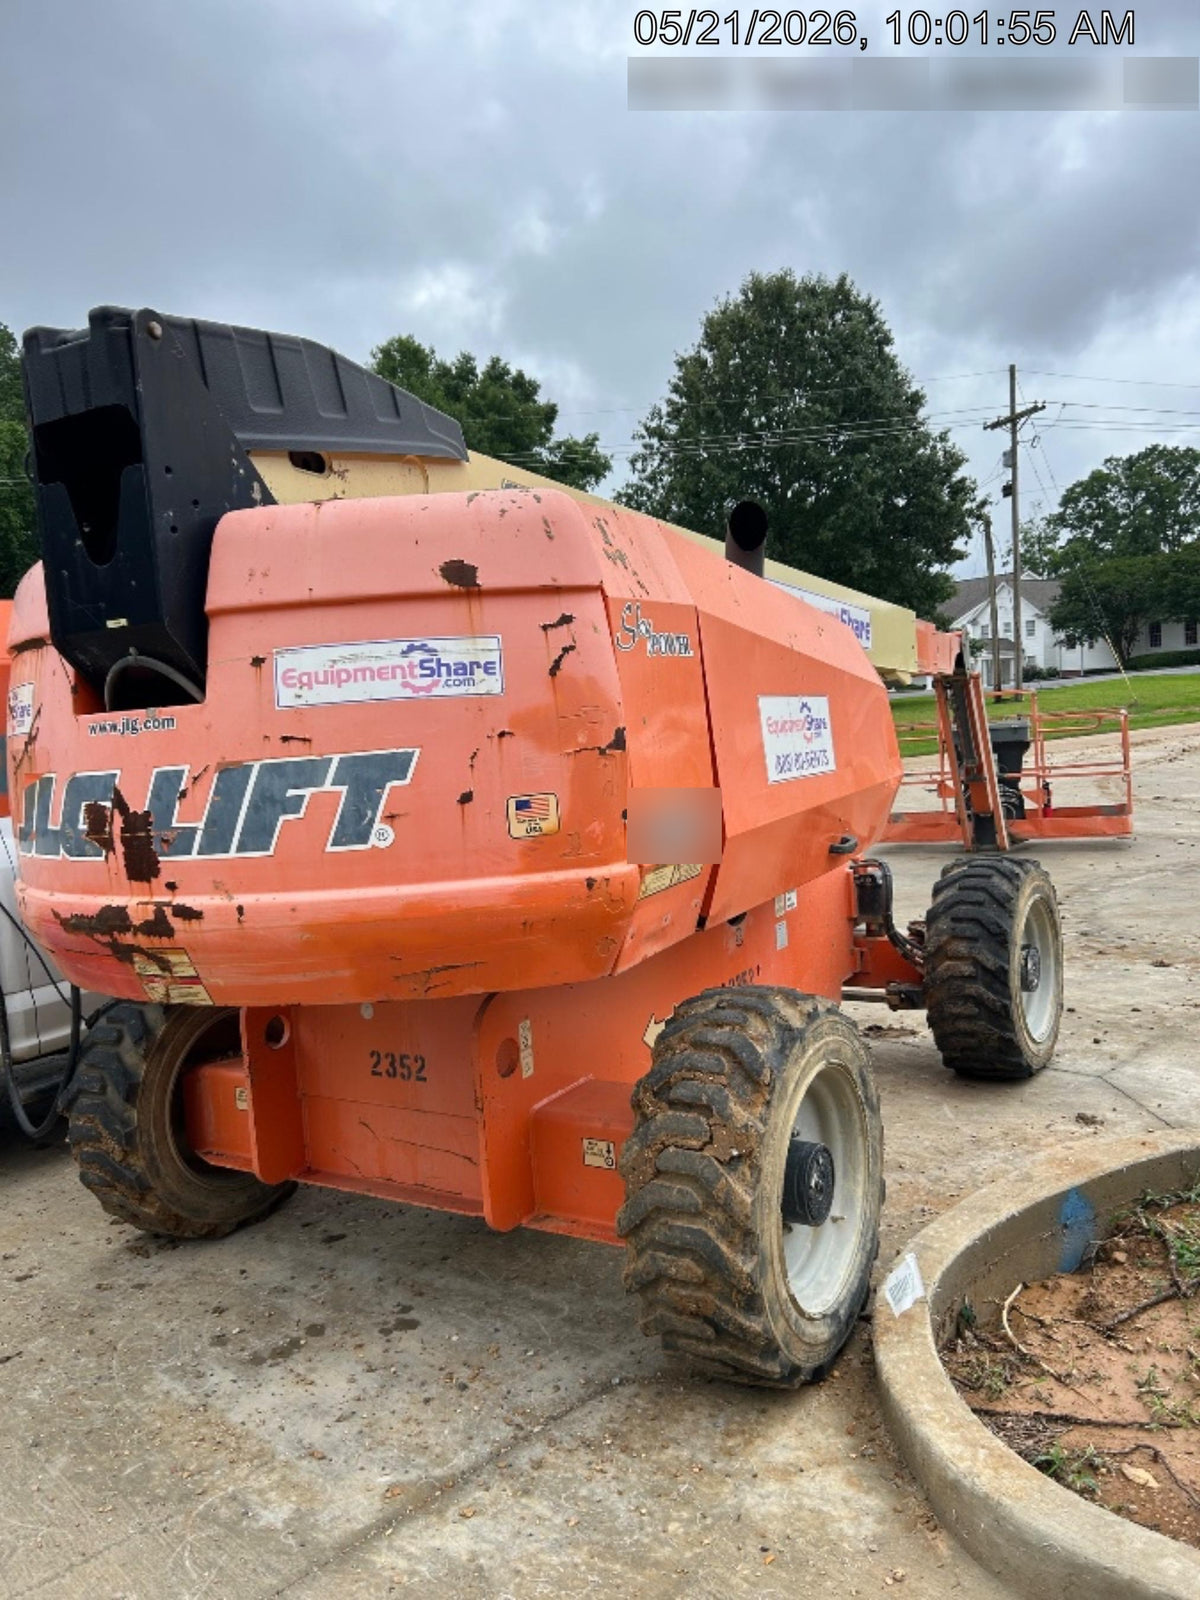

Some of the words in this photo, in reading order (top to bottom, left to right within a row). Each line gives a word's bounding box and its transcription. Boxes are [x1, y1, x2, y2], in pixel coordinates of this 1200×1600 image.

[281, 657, 498, 690] EquipmentShare
[442, 676, 476, 688] .com
[88, 716, 176, 736] www.jlg.com
[18, 769, 121, 860] JLG
[146, 748, 419, 858] LIFT
[369, 1050, 427, 1082] 2352
